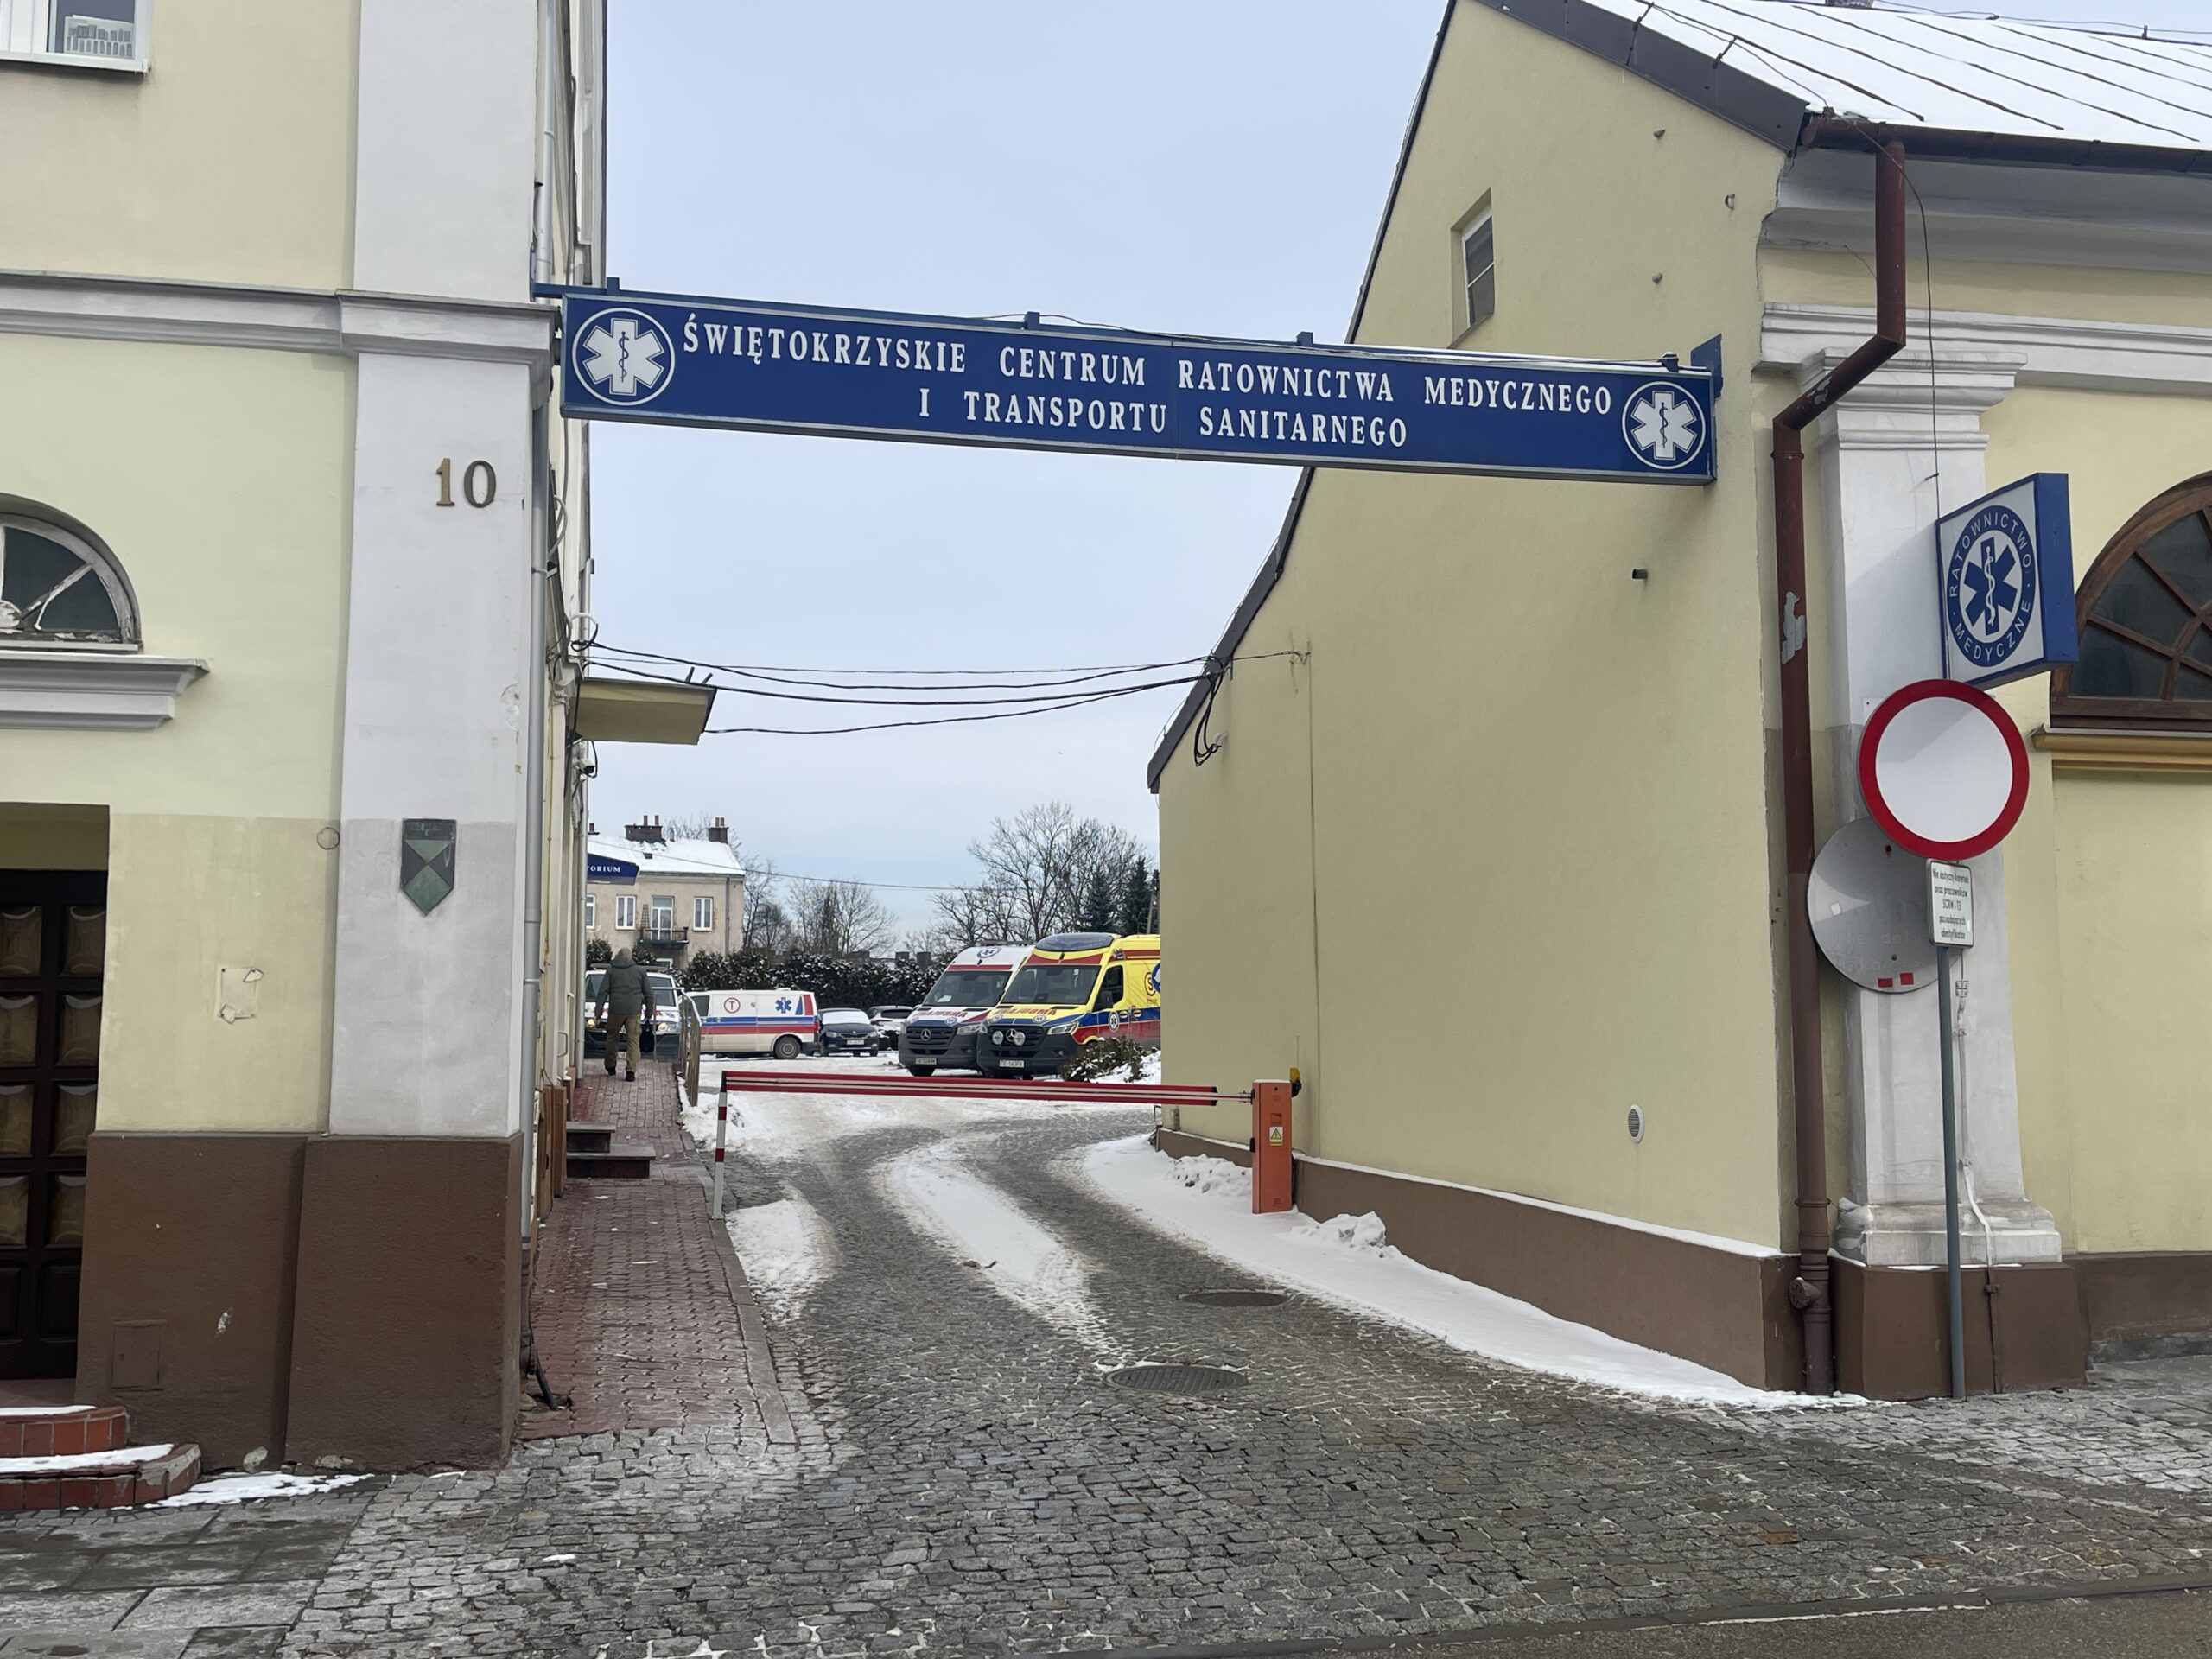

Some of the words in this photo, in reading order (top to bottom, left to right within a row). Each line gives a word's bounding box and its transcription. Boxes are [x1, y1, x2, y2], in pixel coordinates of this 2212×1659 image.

[683, 314, 967, 372] ŚWIĘTOKRZYSKIE
[999, 346, 1146, 385] CENTRUM
[1177, 359, 1395, 402] RATOWNICTWA
[1425, 377, 1612, 416] MEDYCZNEGO
[918, 388, 931, 417] I
[963, 391, 1166, 433] TRANSPORTU
[1199, 407, 1408, 448] SANITARNEGO
[435, 457, 497, 509] 10
[1949, 511, 2033, 598] RATOWNICTWO
[1954, 600, 2031, 662] MEDYCZNE
